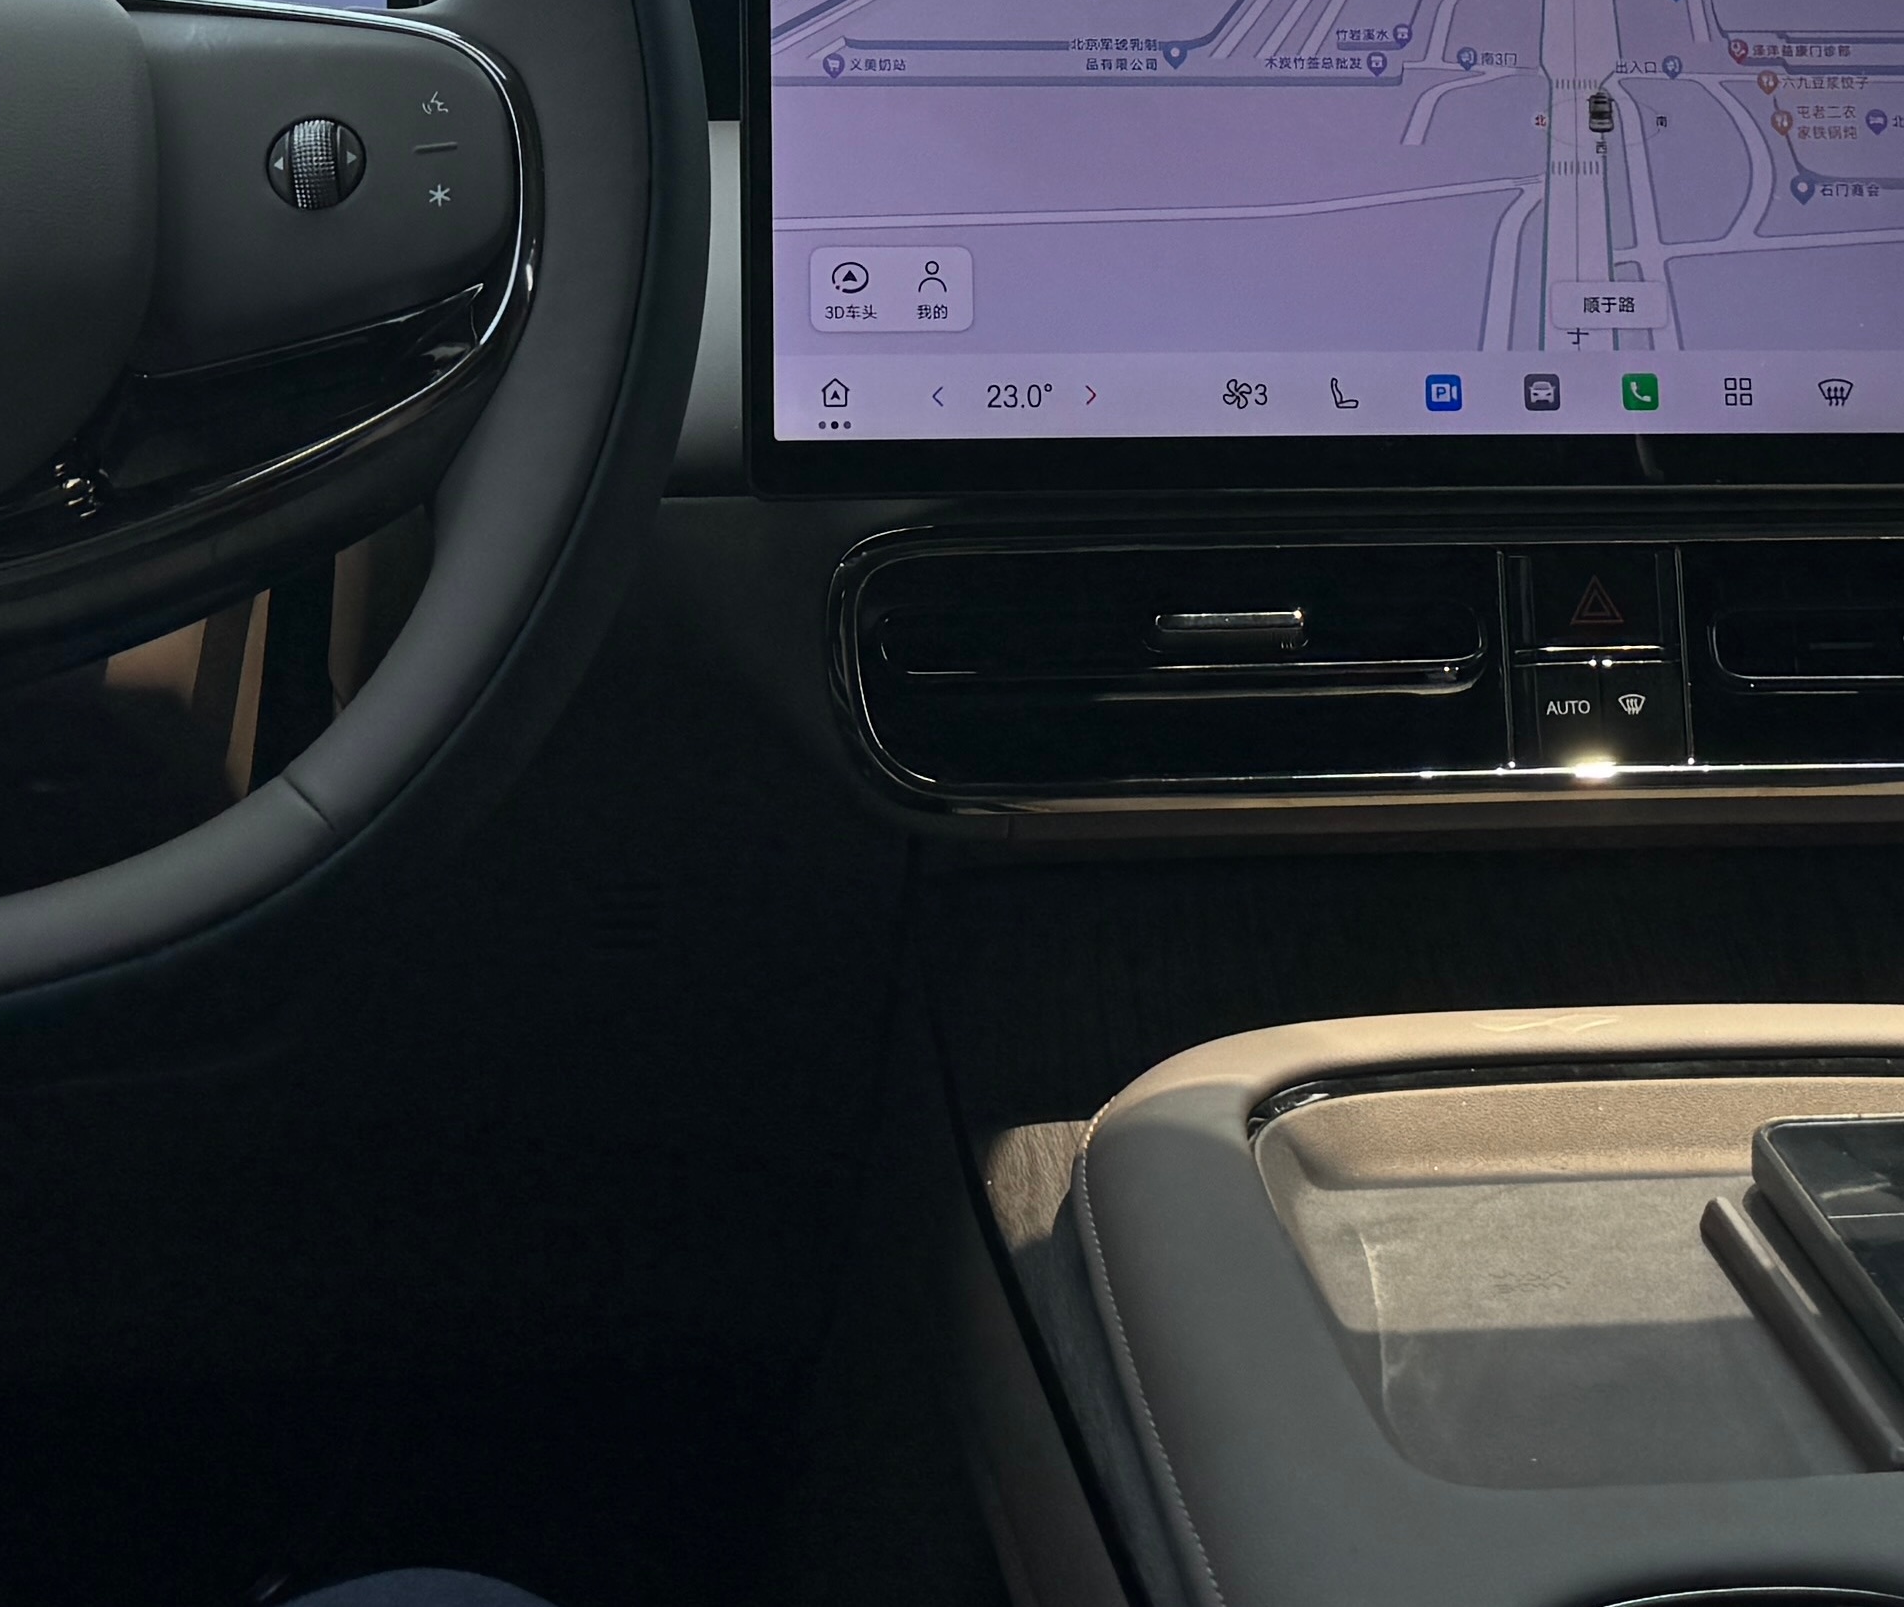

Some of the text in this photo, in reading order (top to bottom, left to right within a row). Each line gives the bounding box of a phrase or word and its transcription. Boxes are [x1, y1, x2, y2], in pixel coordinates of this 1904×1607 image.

[1085, 57, 1158, 72] 品有限公司
[1480, 52, 1518, 66] 南3门
[1615, 60, 1658, 75] 出入口
[1782, 75, 1870, 90] 六九豆浆饺子
[1820, 183, 1881, 197] 石门商会
[824, 304, 878, 321] 3D车头
[916, 304, 948, 321] 我的
[1583, 296, 1635, 313] 顺于路
[986, 382, 1053, 409] 23.0°
[1254, 384, 1268, 406] 3
[1546, 699, 1591, 716] AUTO
